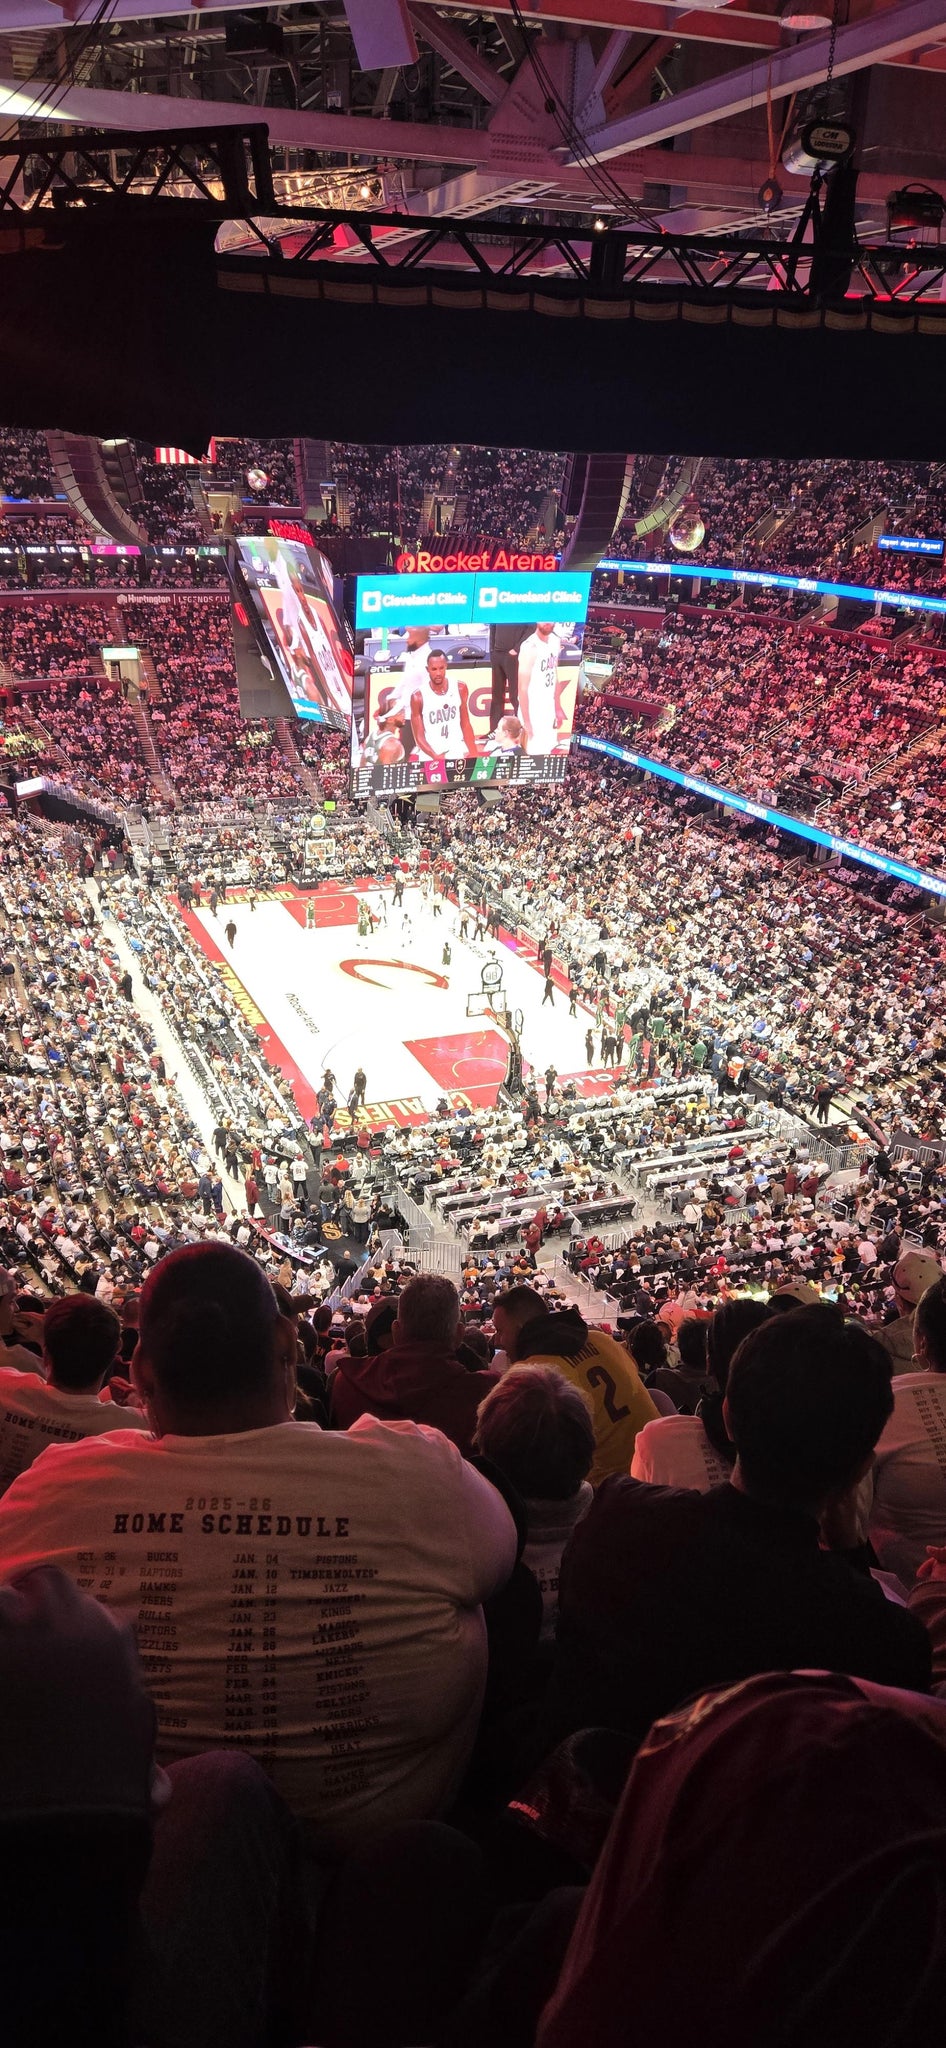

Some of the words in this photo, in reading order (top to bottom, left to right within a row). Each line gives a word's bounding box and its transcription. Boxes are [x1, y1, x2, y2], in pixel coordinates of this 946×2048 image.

[417, 551, 491, 573] Rocket
[493, 550, 557, 572] Arena
[215, 596, 230, 604] CLU
[382, 593, 436, 607] Cleveland
[436, 592, 469, 605] Clinic
[499, 591, 551, 603] Cleveland
[552, 590, 583, 603] Clinic
[369, 665, 391, 673] anc
[429, 703, 457, 725] CAVS
[441, 724, 450, 740] 4
[453, 774, 466, 783] 22.5
[586, 1365, 632, 1424] 2
[4, 1411, 36, 1430] HOME
[184, 1497, 272, 1511] 2025-26
[112, 1512, 185, 1534] HOME
[201, 1513, 350, 1538] SCHEDULE
[147, 1552, 179, 1562] BUCKS
[232, 1553, 256, 1565] JAN.
[265, 1554, 279, 1565] 04
[314, 1554, 358, 1565] PISTONS
[139, 1566, 184, 1578] RAPTORS
[231, 1569, 258, 1580] JAN.
[266, 1569, 278, 1580] 10
[139, 1581, 178, 1592] HAWKS
[230, 1584, 255, 1594] JAN.
[265, 1584, 278, 1594] 12
[322, 1583, 349, 1594] JAZZ
[141, 1595, 174, 1607] 76ERS
[229, 1598, 257, 1608] JAN.
[138, 1608, 171, 1621] BULLS
[263, 1611, 277, 1622] 23
[320, 1606, 352, 1619] KINGS
[229, 1627, 256, 1638] JAN.
[227, 1642, 255, 1652] JAN.
[224, 1679, 252, 1689] FEB.
[262, 1677, 276, 1688] 24
[225, 1693, 253, 1703] MAR.
[262, 1691, 277, 1702] 03
[318, 1679, 366, 1696] PISTONS
[225, 1707, 257, 1718] MAR.
[331, 1741, 361, 1755] HEAT
